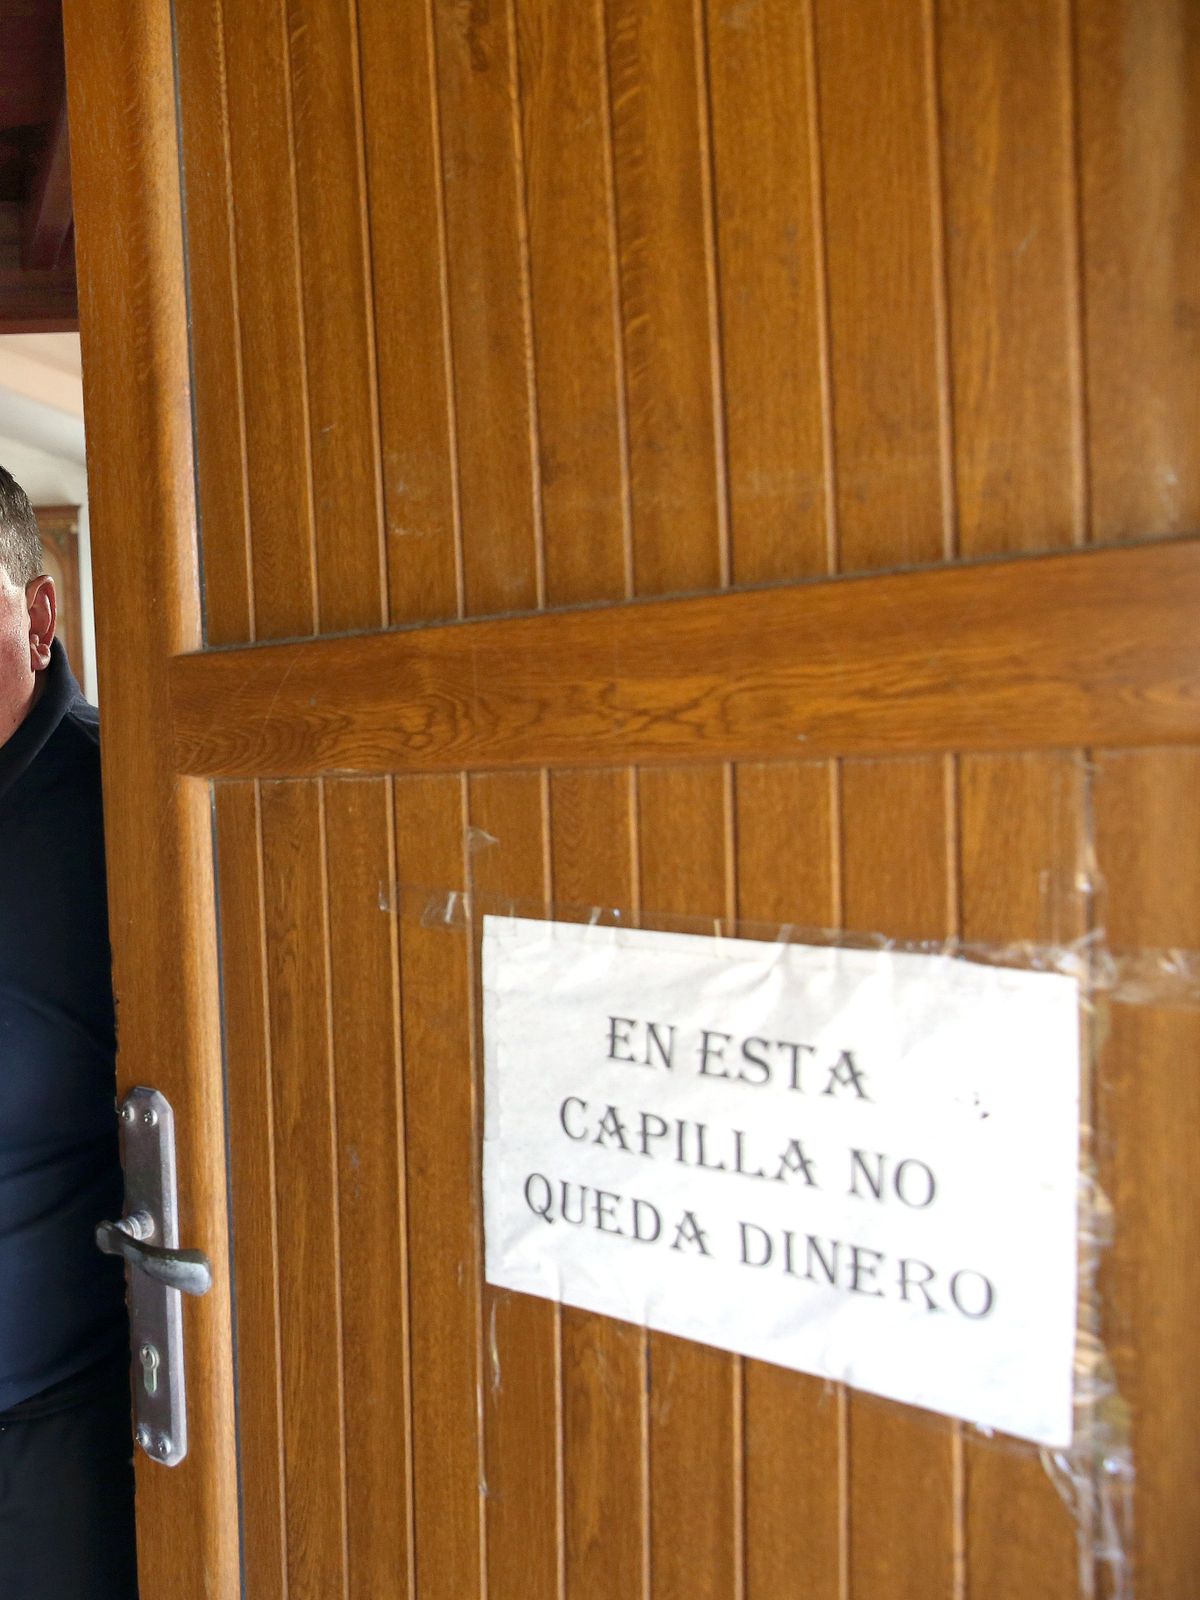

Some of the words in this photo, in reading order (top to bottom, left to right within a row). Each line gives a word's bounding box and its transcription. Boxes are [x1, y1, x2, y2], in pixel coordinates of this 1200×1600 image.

[606, 1015, 677, 1071] EN
[697, 1030, 874, 1101] ESTA
[559, 1096, 819, 1188] CAPILLA
[850, 1148, 938, 1209] NO
[523, 1172, 712, 1257] QUEDA
[738, 1221, 997, 1320] DINERO
